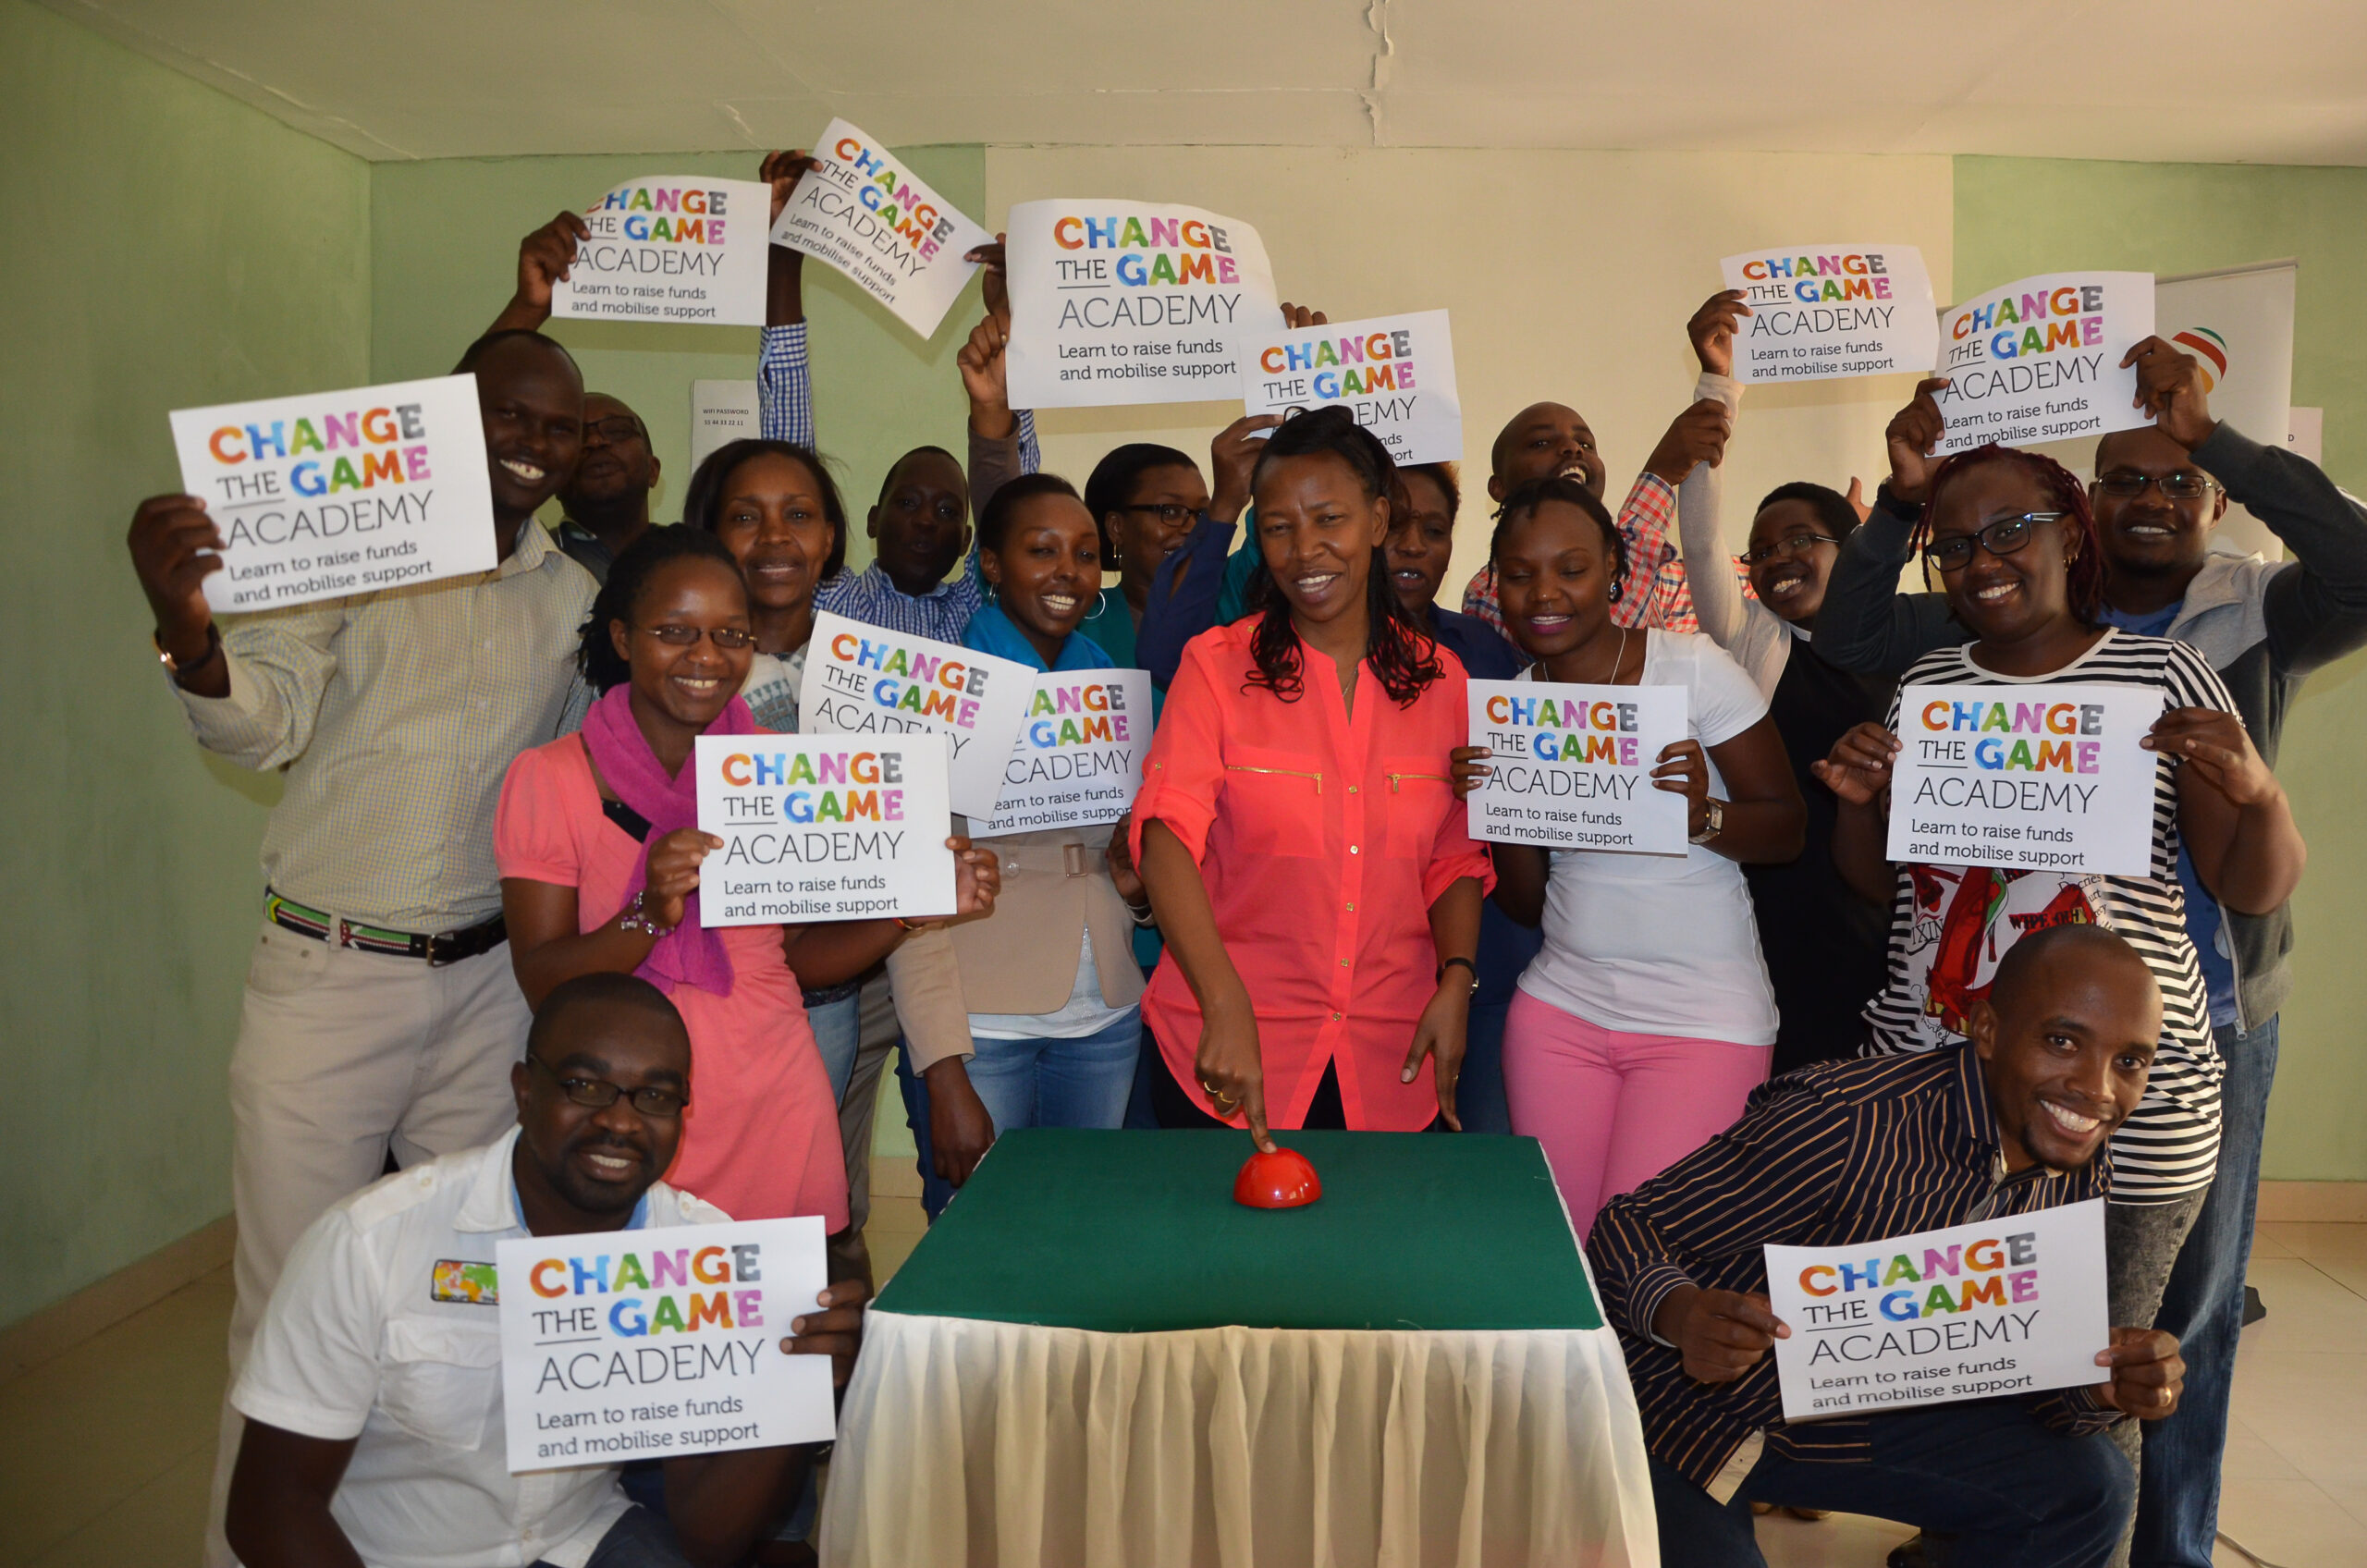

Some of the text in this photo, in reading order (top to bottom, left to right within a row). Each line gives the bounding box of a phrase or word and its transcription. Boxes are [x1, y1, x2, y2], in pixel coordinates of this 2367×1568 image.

[835, 138, 955, 245] CHANGE
[823, 159, 940, 263] THE GAME
[624, 215, 725, 245] GAME
[801, 186, 926, 277] ACADEMY
[1053, 216, 1232, 253] CHANGE
[573, 246, 725, 276] ACADEMY
[781, 230, 896, 303] and mobilise support
[790, 214, 897, 286] Learn to raise funds
[1742, 254, 1887, 281] CHANGE
[1055, 252, 1239, 287] THE GAME
[573, 281, 706, 300] Learn to raise funds
[1747, 277, 1893, 303] THE GAME
[571, 300, 715, 319] and mobilise support
[1058, 294, 1242, 329] ACADEMY
[1750, 306, 1895, 337] ACADEMY
[1952, 286, 2103, 341] CHANGE
[1059, 338, 1223, 359] Learn to raise funds
[1260, 330, 1412, 374] CHANGE
[1751, 340, 1883, 360] Learn to raise funds
[1948, 316, 2103, 364] THE GAME
[1060, 361, 1237, 381] and mobilise support
[1263, 361, 1416, 399] THE GAME
[1752, 358, 1894, 377] and mobilise support
[1943, 352, 2104, 404] ACADEMY
[1944, 398, 2089, 430] Learn to raise funds
[208, 404, 424, 465] CHANGE
[1379, 433, 1403, 446] nds
[1945, 416, 2101, 448] and mobilise support
[216, 445, 431, 499] THE GAME
[227, 489, 434, 549] ACADEMY
[230, 540, 417, 581] Learn to raise funds
[234, 560, 432, 604] and mobilise support
[831, 633, 988, 697] CHANGE
[826, 665, 980, 729] THE GAME
[1024, 684, 1126, 717] ANGE
[1486, 695, 1638, 732] CHANGE
[1029, 715, 1130, 749] GAME
[1921, 700, 2104, 735] CHANGE
[1487, 732, 1638, 766] THE GAME
[1919, 738, 2101, 774] THE GAME
[721, 752, 902, 787] CHANGE
[1002, 749, 1132, 785] CADEMY
[1486, 766, 1639, 801] ACADEMY
[723, 790, 903, 824] THE GAME
[995, 786, 1124, 811] earn to raise funds
[1913, 777, 2098, 814] ACADEMY
[988, 804, 1132, 830] and mobilise suppor
[1486, 802, 1622, 826] Learn to raise funds
[1912, 818, 2073, 842] Learn to raise funds
[725, 830, 904, 865] ACADEMY
[1486, 824, 1634, 846] and mobilise support
[1909, 841, 2084, 867] and mobilise support
[725, 875, 886, 895] Learn to raise funds
[725, 897, 899, 917] and mobilise support
[529, 1243, 761, 1299] CHANGE
[1798, 1231, 2037, 1297] CHANGE
[532, 1290, 764, 1338] THE GAME
[1802, 1269, 2039, 1324] THE GAME
[1809, 1310, 2040, 1366] ACADEMY
[535, 1339, 765, 1394] ACADEMY
[1810, 1357, 2017, 1390] Learn to raise funds
[1813, 1375, 2032, 1408] and mobilise support
[537, 1396, 742, 1429] Learn to raise funds
[538, 1423, 759, 1457] and mobilise support
